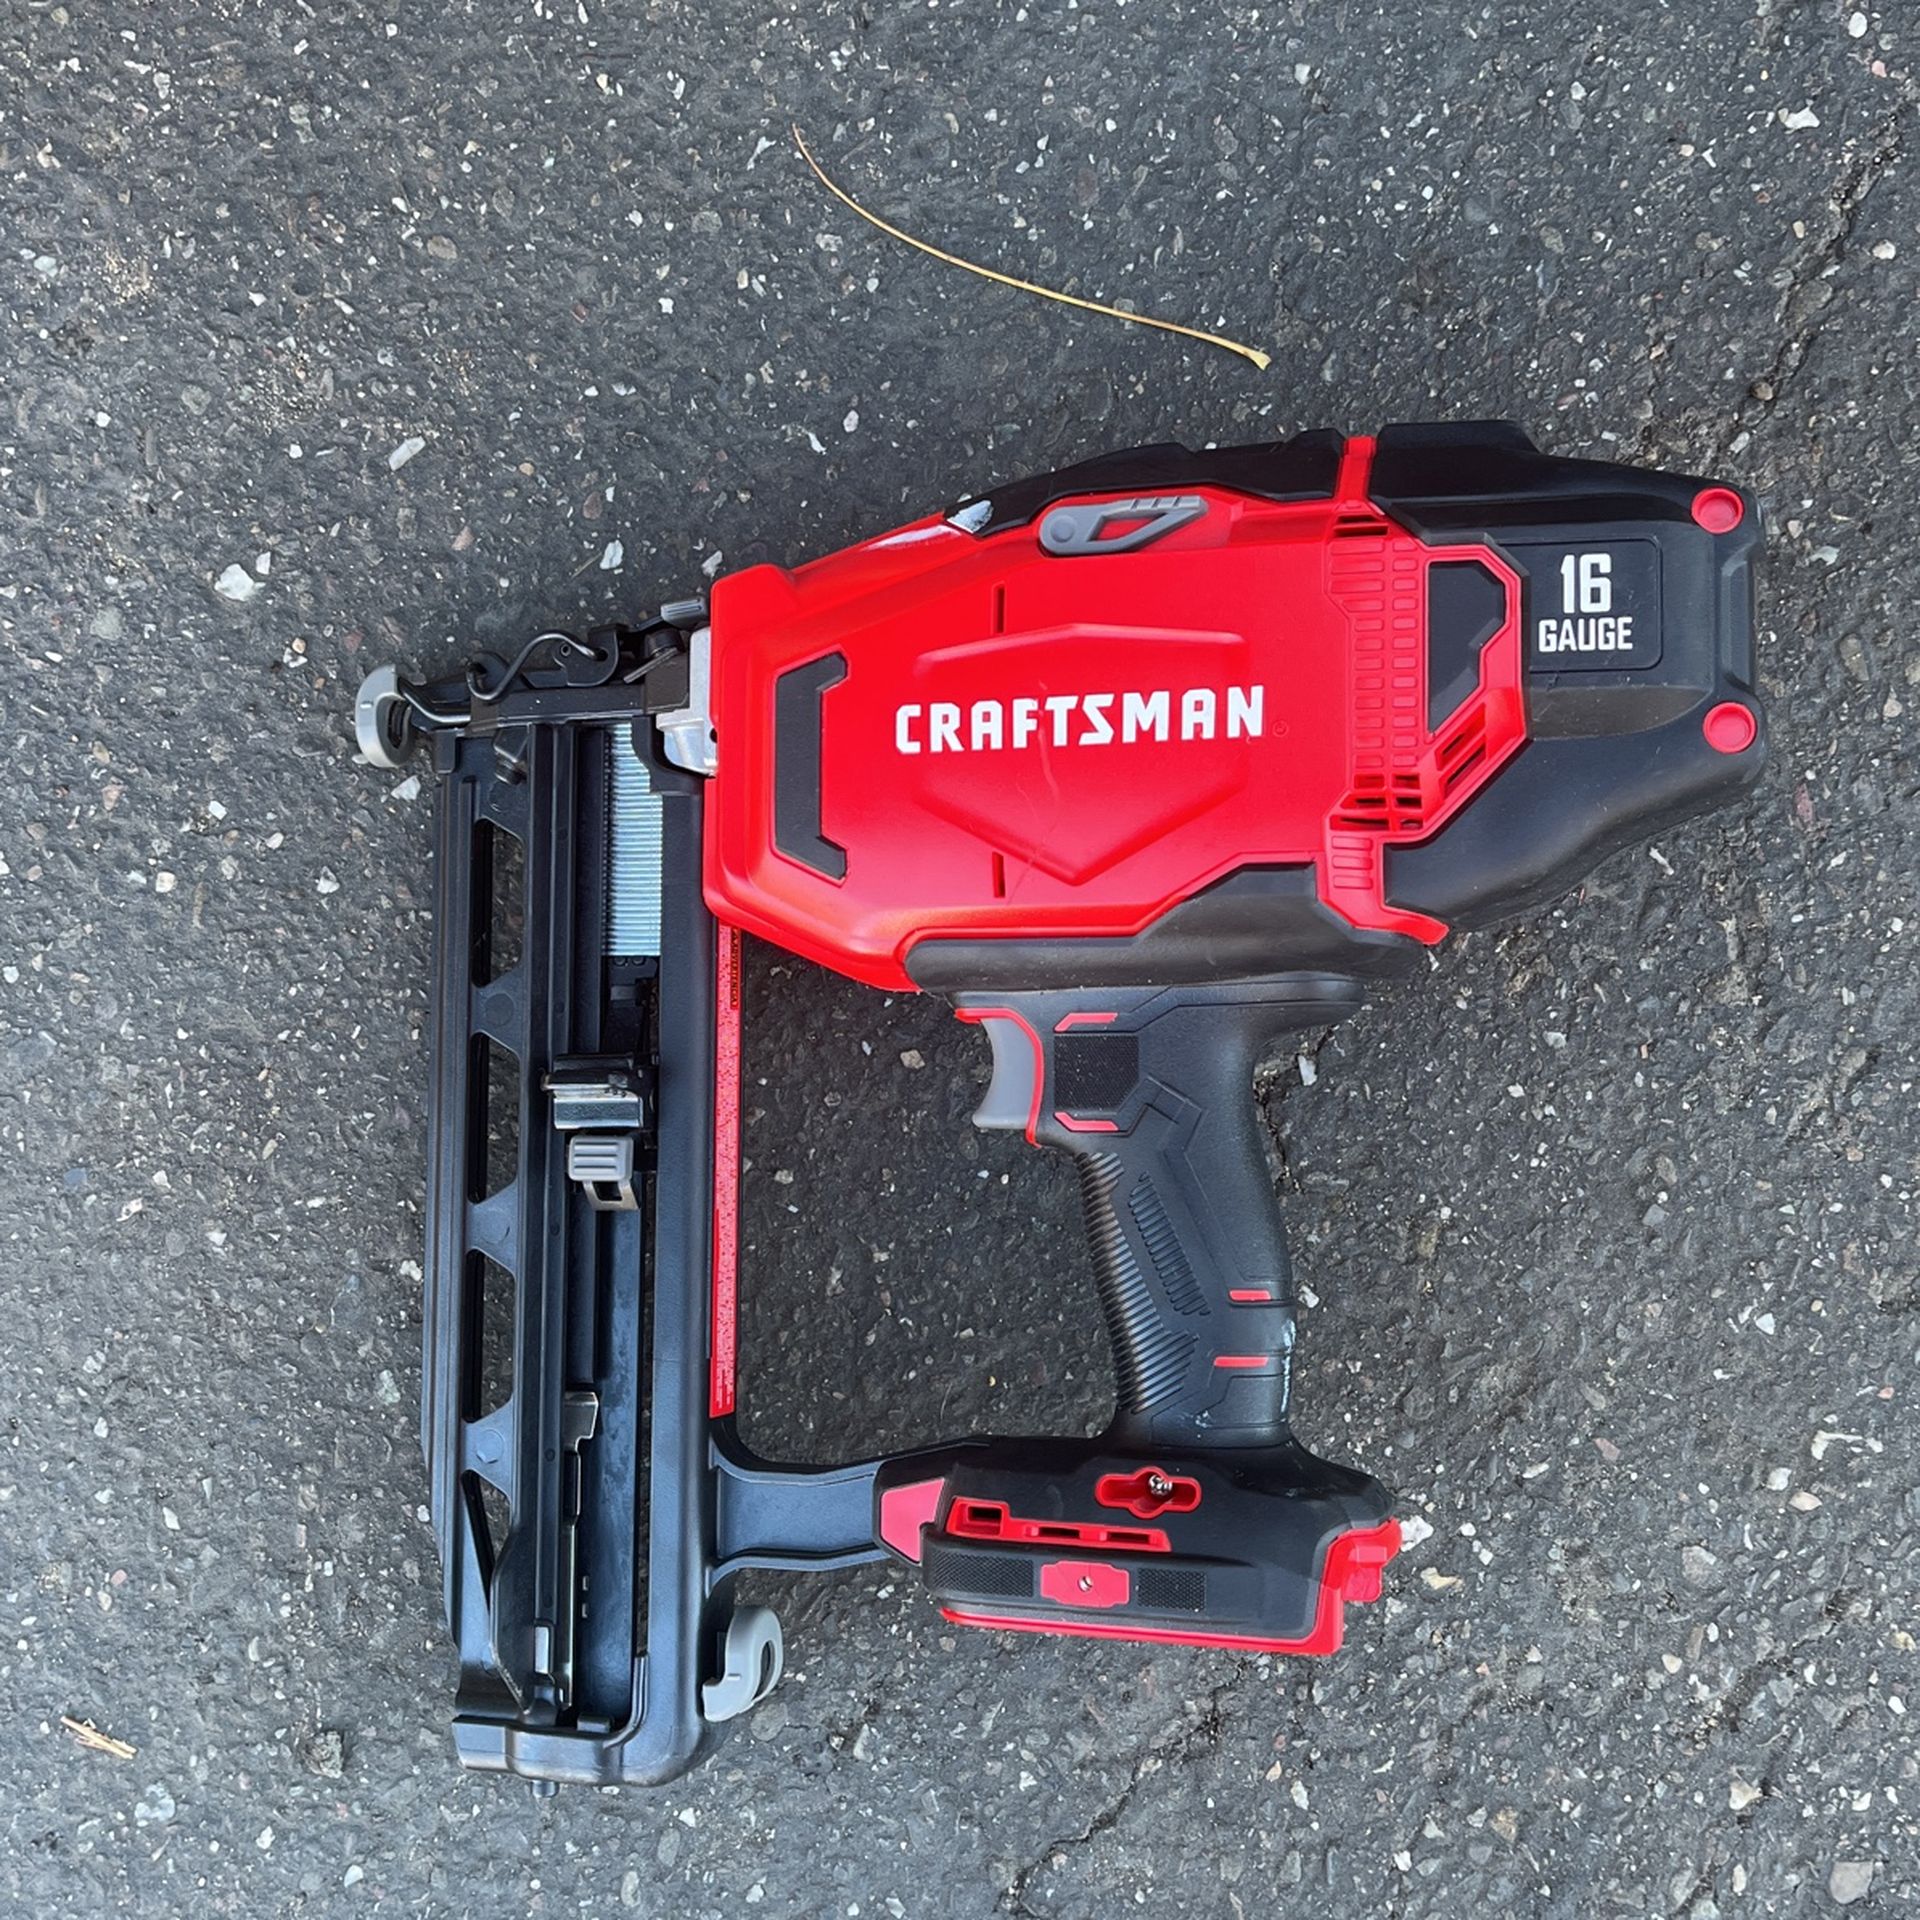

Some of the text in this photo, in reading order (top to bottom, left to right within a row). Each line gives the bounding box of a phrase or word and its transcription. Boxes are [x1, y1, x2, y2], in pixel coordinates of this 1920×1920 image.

[1560, 553, 1612, 614] 16
[1538, 616, 1634, 653] GAUGE
[895, 685, 1264, 754] CRAFTSMAN
